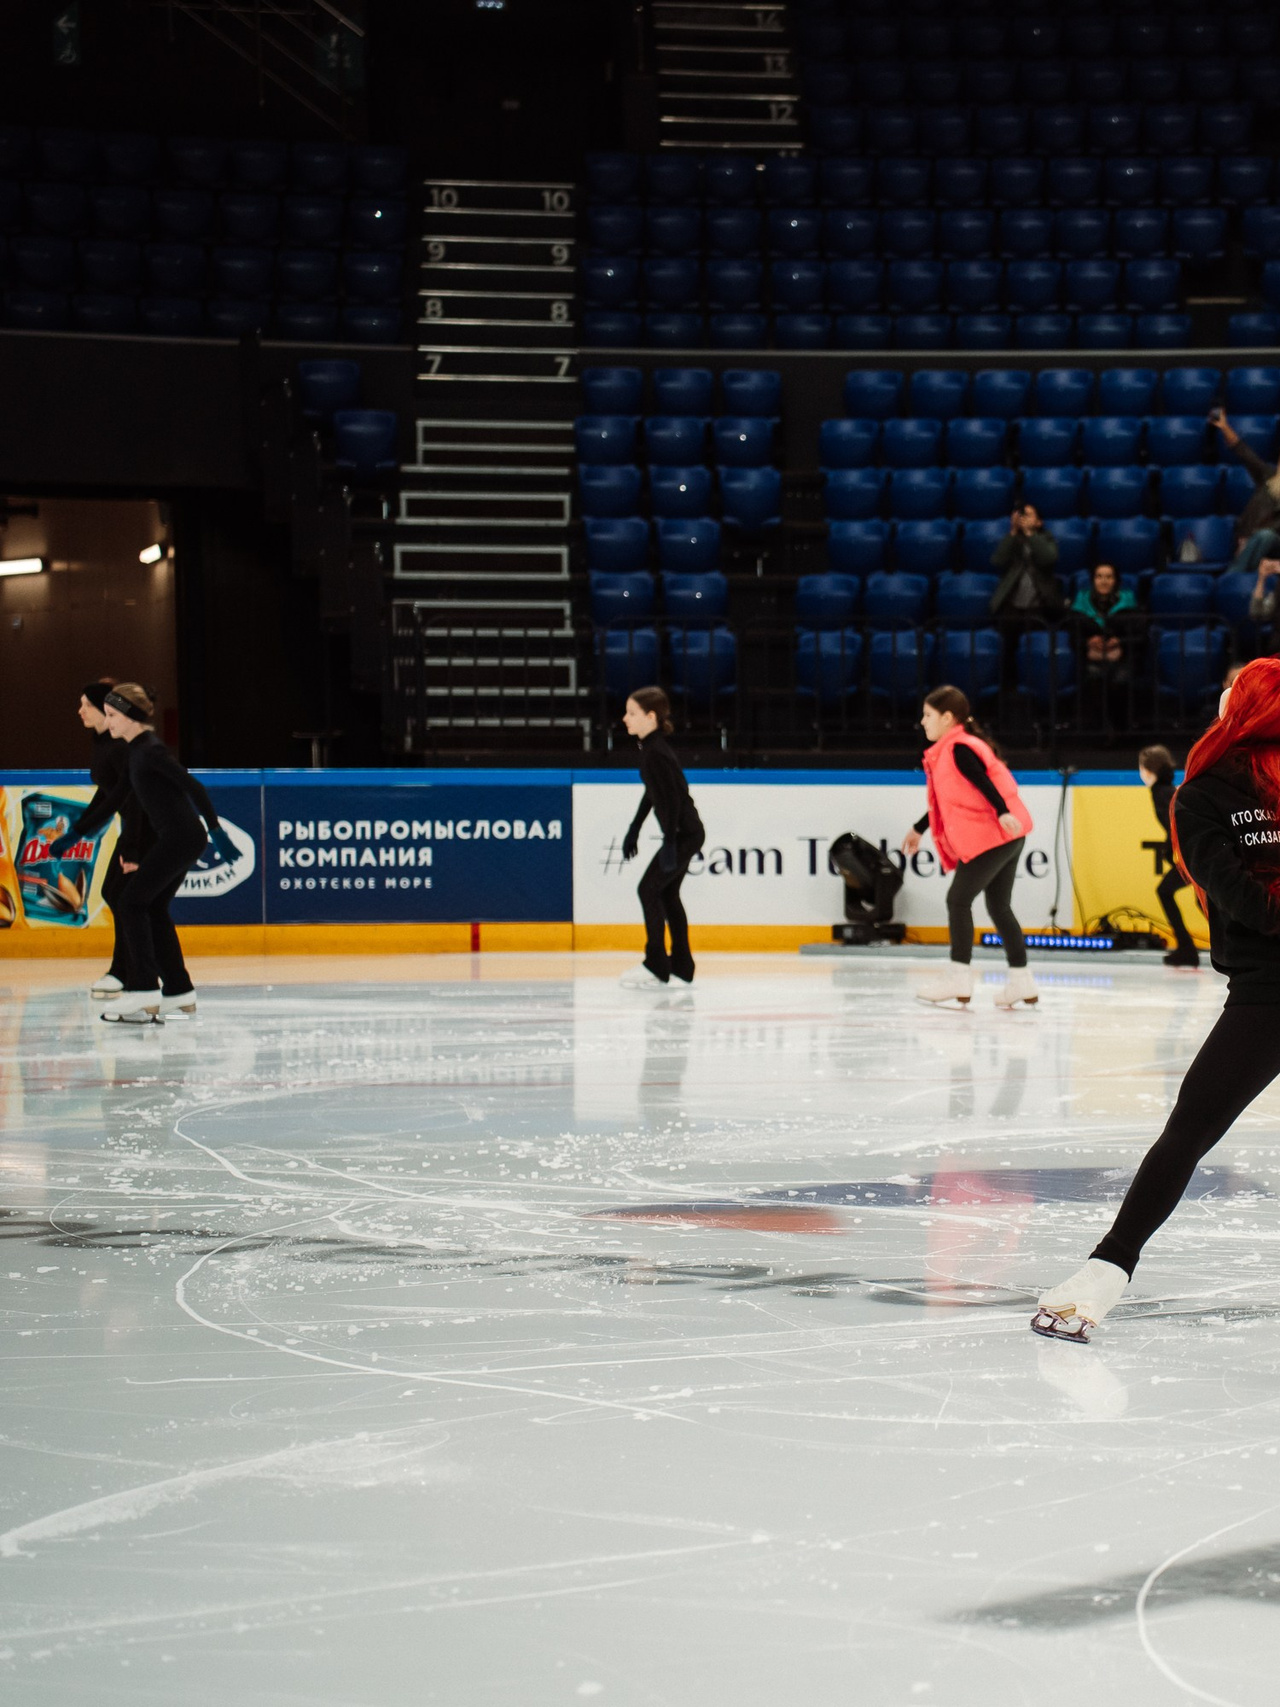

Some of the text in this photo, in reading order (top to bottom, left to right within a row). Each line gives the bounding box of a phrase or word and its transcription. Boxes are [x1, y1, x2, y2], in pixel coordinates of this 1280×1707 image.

[431, 188, 458, 207] 10
[542, 190, 570, 211] 10
[427, 241, 445, 261] 9
[551, 245, 569, 265] 9
[425, 299, 443, 319] 8
[551, 301, 568, 322] 8
[425, 353, 442, 374] 7
[554, 356, 571, 377] 7
[1230, 810, 1253, 827] КТО
[278, 819, 563, 841] РЫБОПРОМЫСЛОВАЯ
[279, 846, 433, 868] КОМПАНИЯ
[279, 877, 433, 890] ОХОТСКОЕ МОРЕ
